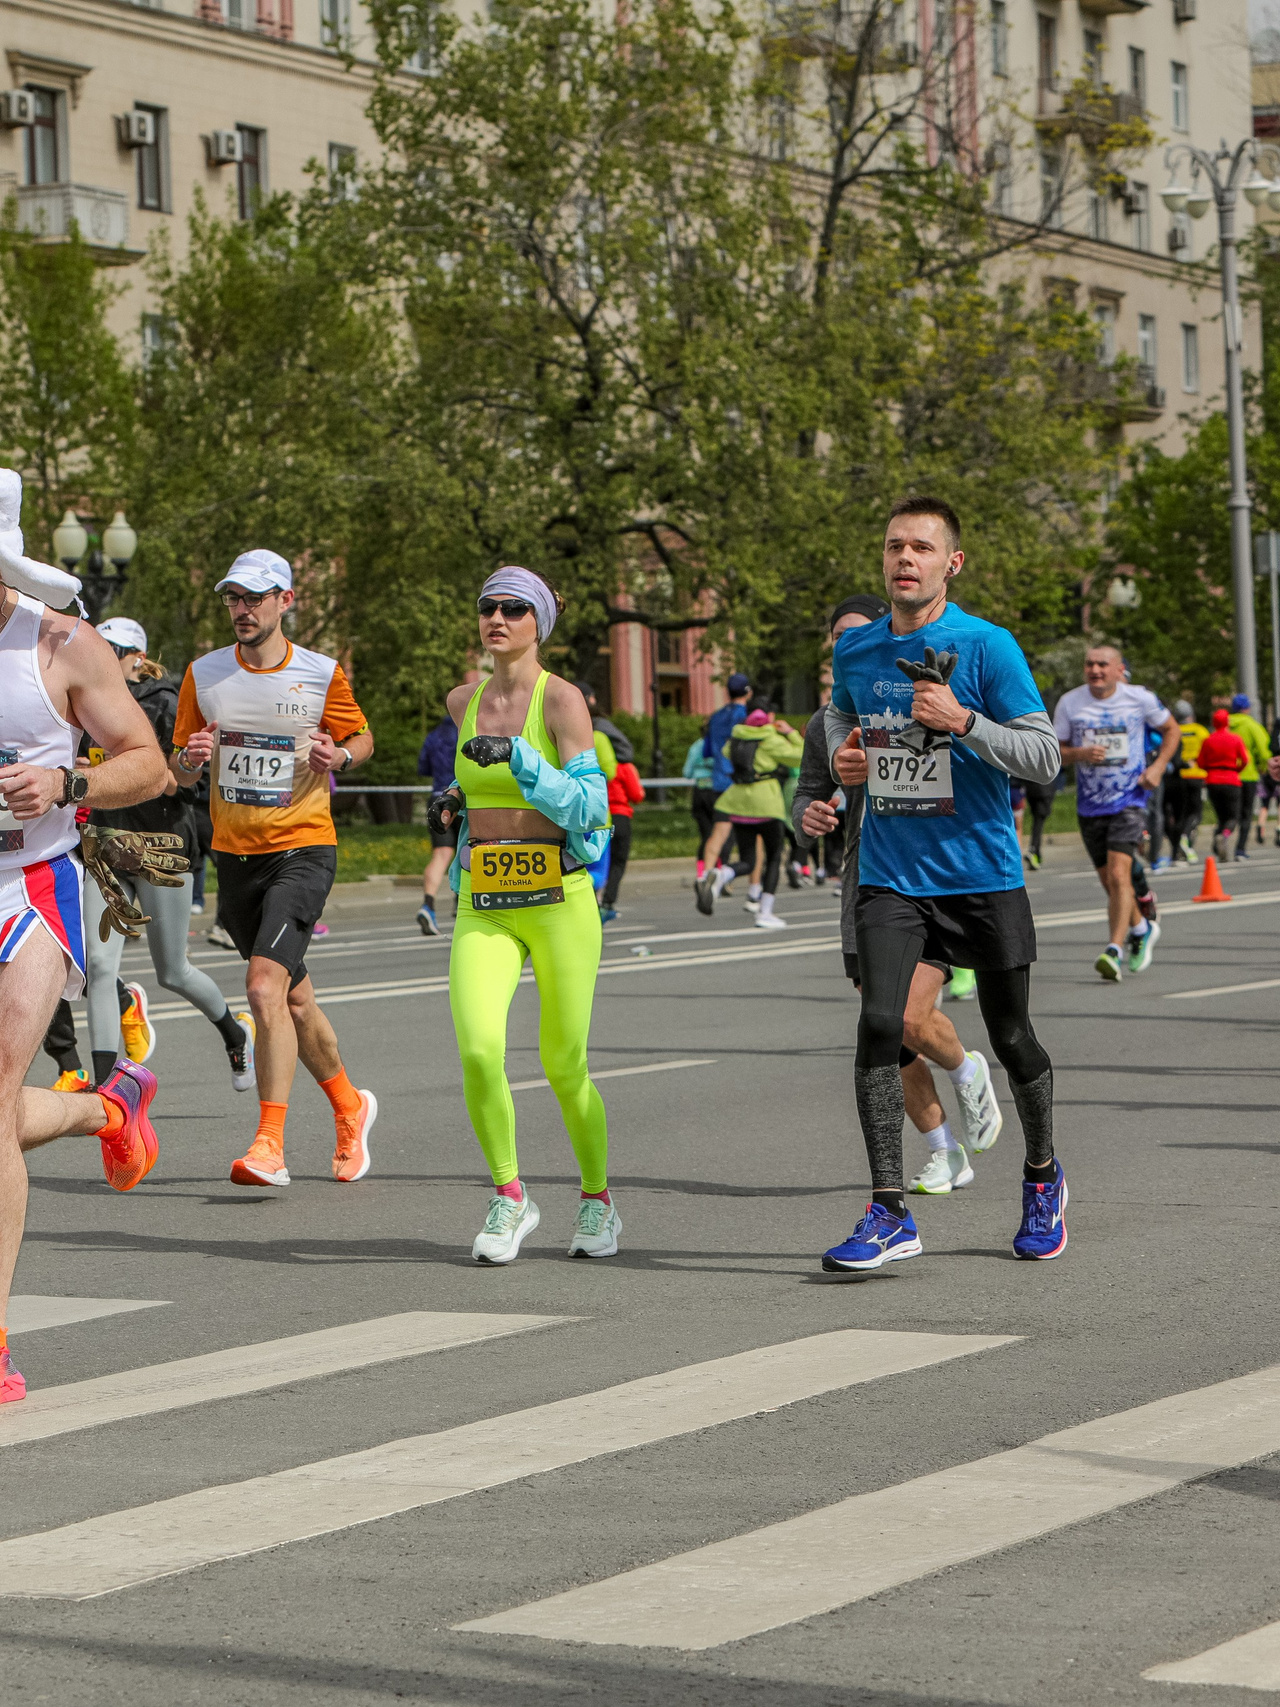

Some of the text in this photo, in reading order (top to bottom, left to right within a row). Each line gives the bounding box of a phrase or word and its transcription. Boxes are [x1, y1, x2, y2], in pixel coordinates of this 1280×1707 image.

[275, 703, 308, 716] TIRS
[228, 753, 282, 777] 4119
[877, 756, 937, 782] 8792
[238, 777, 268, 786] ДМИТРИЙ
[893, 783, 919, 792] СЕРГЕЙ
[483, 852, 547, 877] 5958
[499, 879, 533, 887] ТАТЬЯНА
